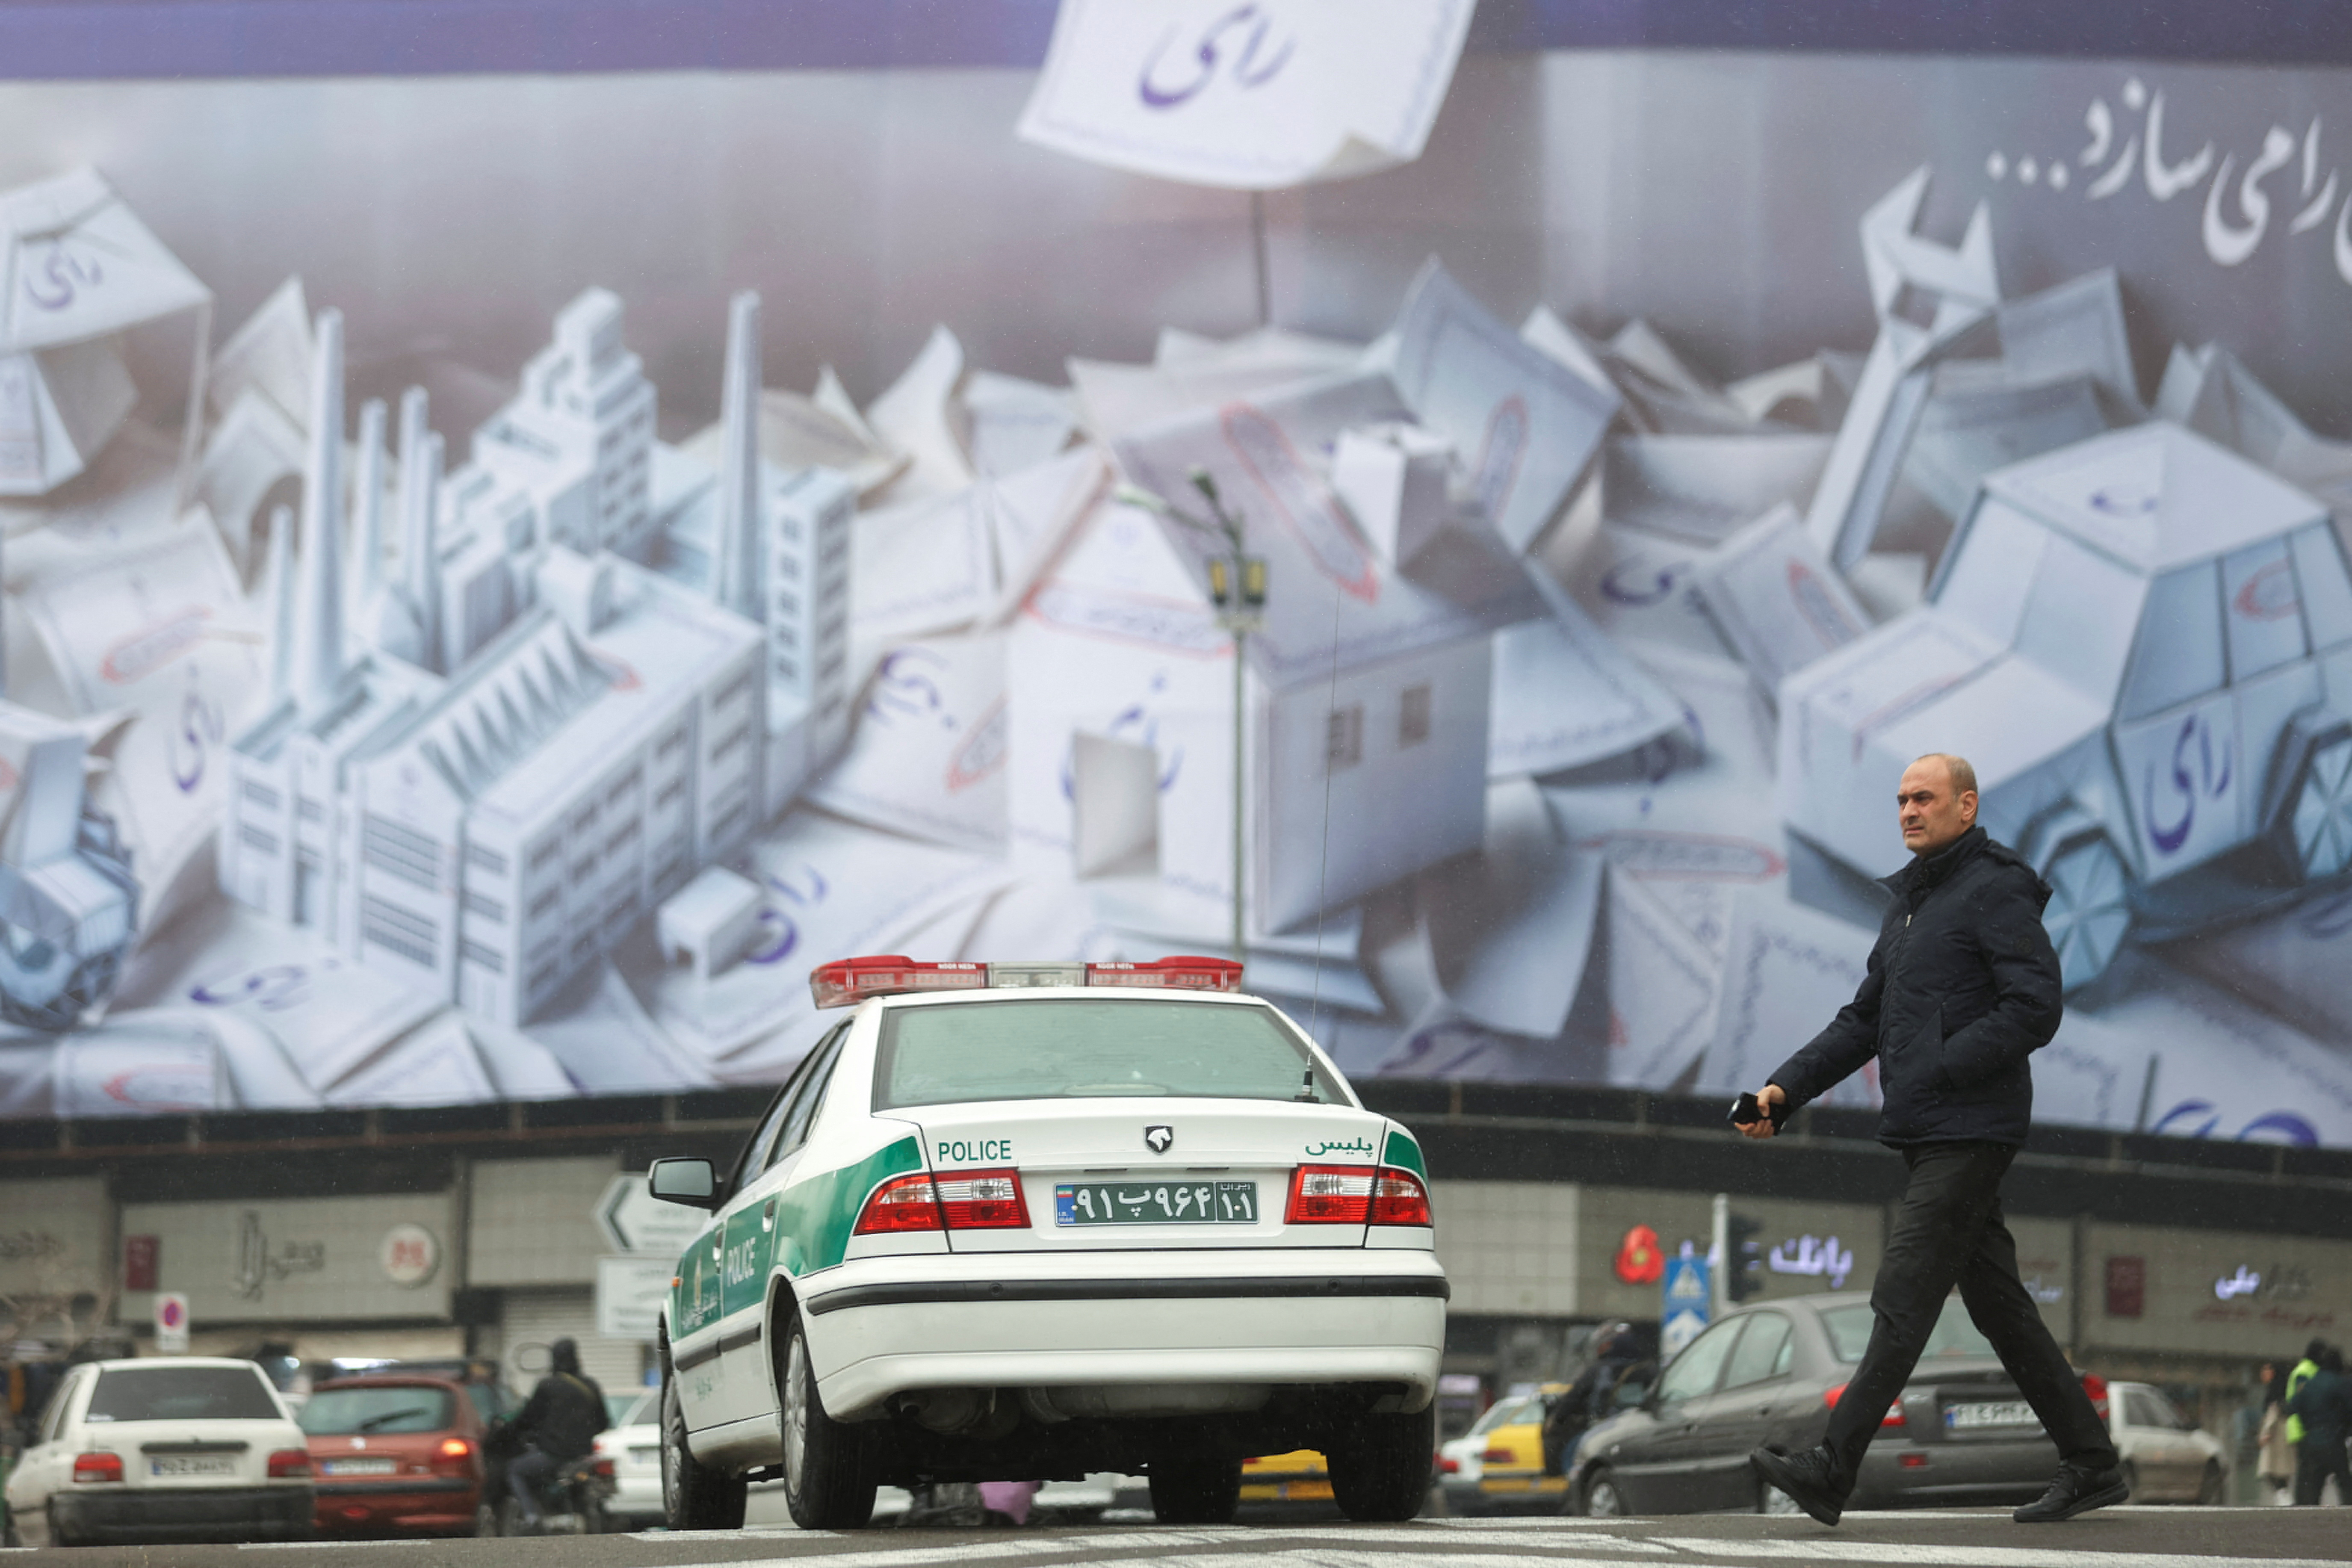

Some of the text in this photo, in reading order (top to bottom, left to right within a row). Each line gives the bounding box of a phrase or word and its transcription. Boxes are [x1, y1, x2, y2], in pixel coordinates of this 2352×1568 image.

[939, 1140, 1012, 1162] POLICE
[1305, 1137, 1373, 1158] پلیس
[728, 1237, 756, 1287] POLICE
